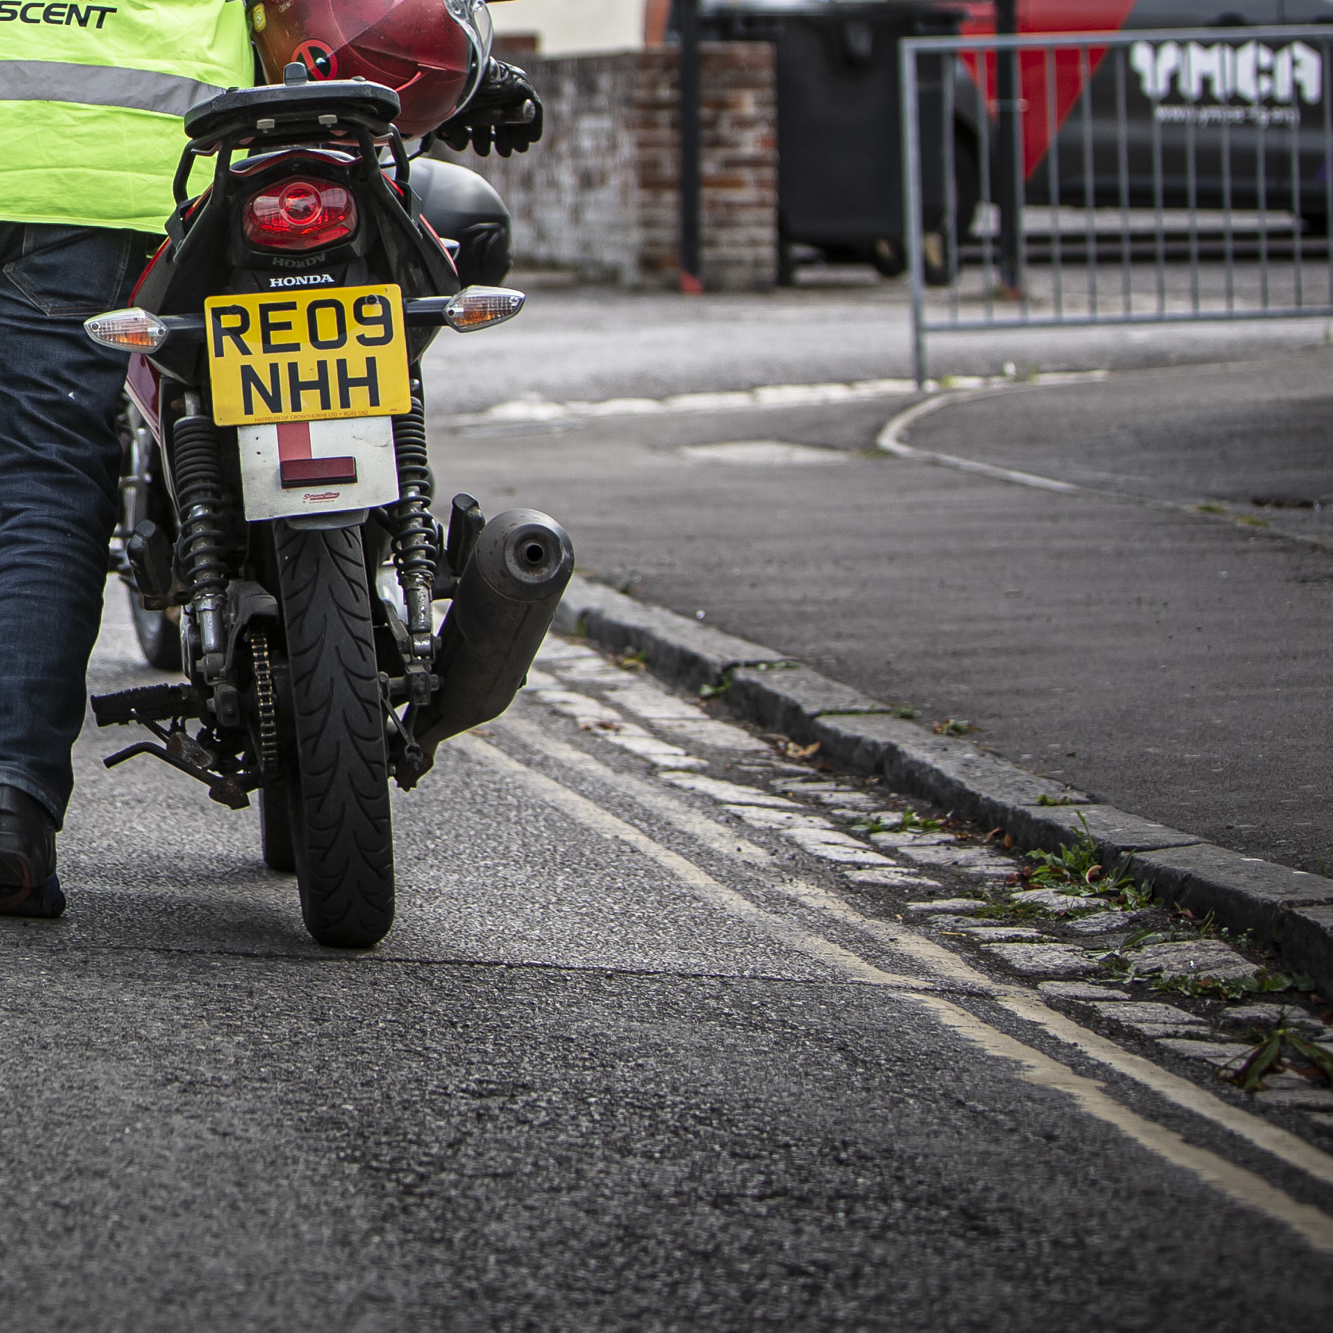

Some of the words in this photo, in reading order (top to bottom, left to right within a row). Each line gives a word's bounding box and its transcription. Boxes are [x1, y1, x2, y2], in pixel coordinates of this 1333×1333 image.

[1131, 39, 1323, 104] YMCA
[269, 274, 335, 288] HONDA
[210, 294, 394, 358] RE09
[240, 356, 381, 415] NHH
